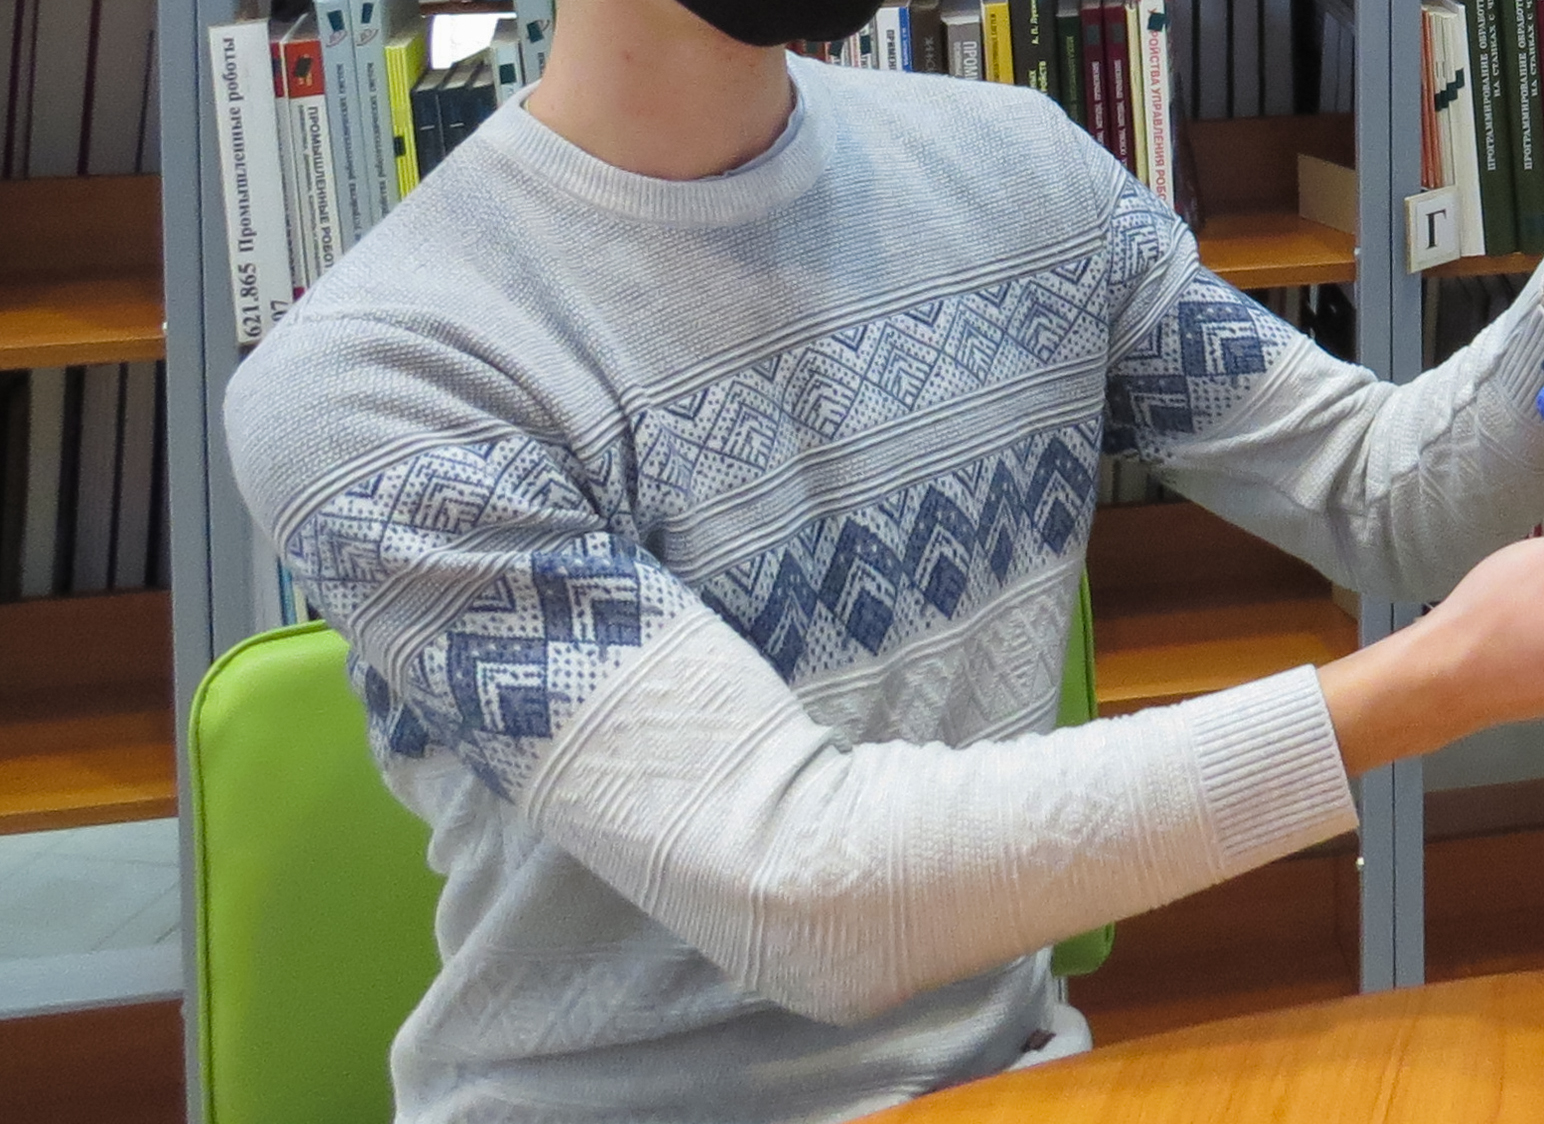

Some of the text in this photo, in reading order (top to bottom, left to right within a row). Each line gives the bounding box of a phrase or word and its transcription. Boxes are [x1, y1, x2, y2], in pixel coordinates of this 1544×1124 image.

[1489, 25, 1500, 76] СТАНКАХ
[1528, 22, 1537, 76] СТАНКАХ
[1481, 54, 1496, 171] ПРОГРАММИРОВАНИЕ
[1493, 80, 1501, 97] НА
[1518, 53, 1533, 170] ПРОГРАММИРОВАНИЕ
[1531, 80, 1538, 96] НА
[1152, 88, 1165, 167] УПРАВЛЕНИЯ
[221, 37, 262, 337] 621.865 Промышленные роботы
[308, 106, 329, 224] ПРОМЫШЛЕННЫЕ
[1425, 207, 1448, 249] Г
